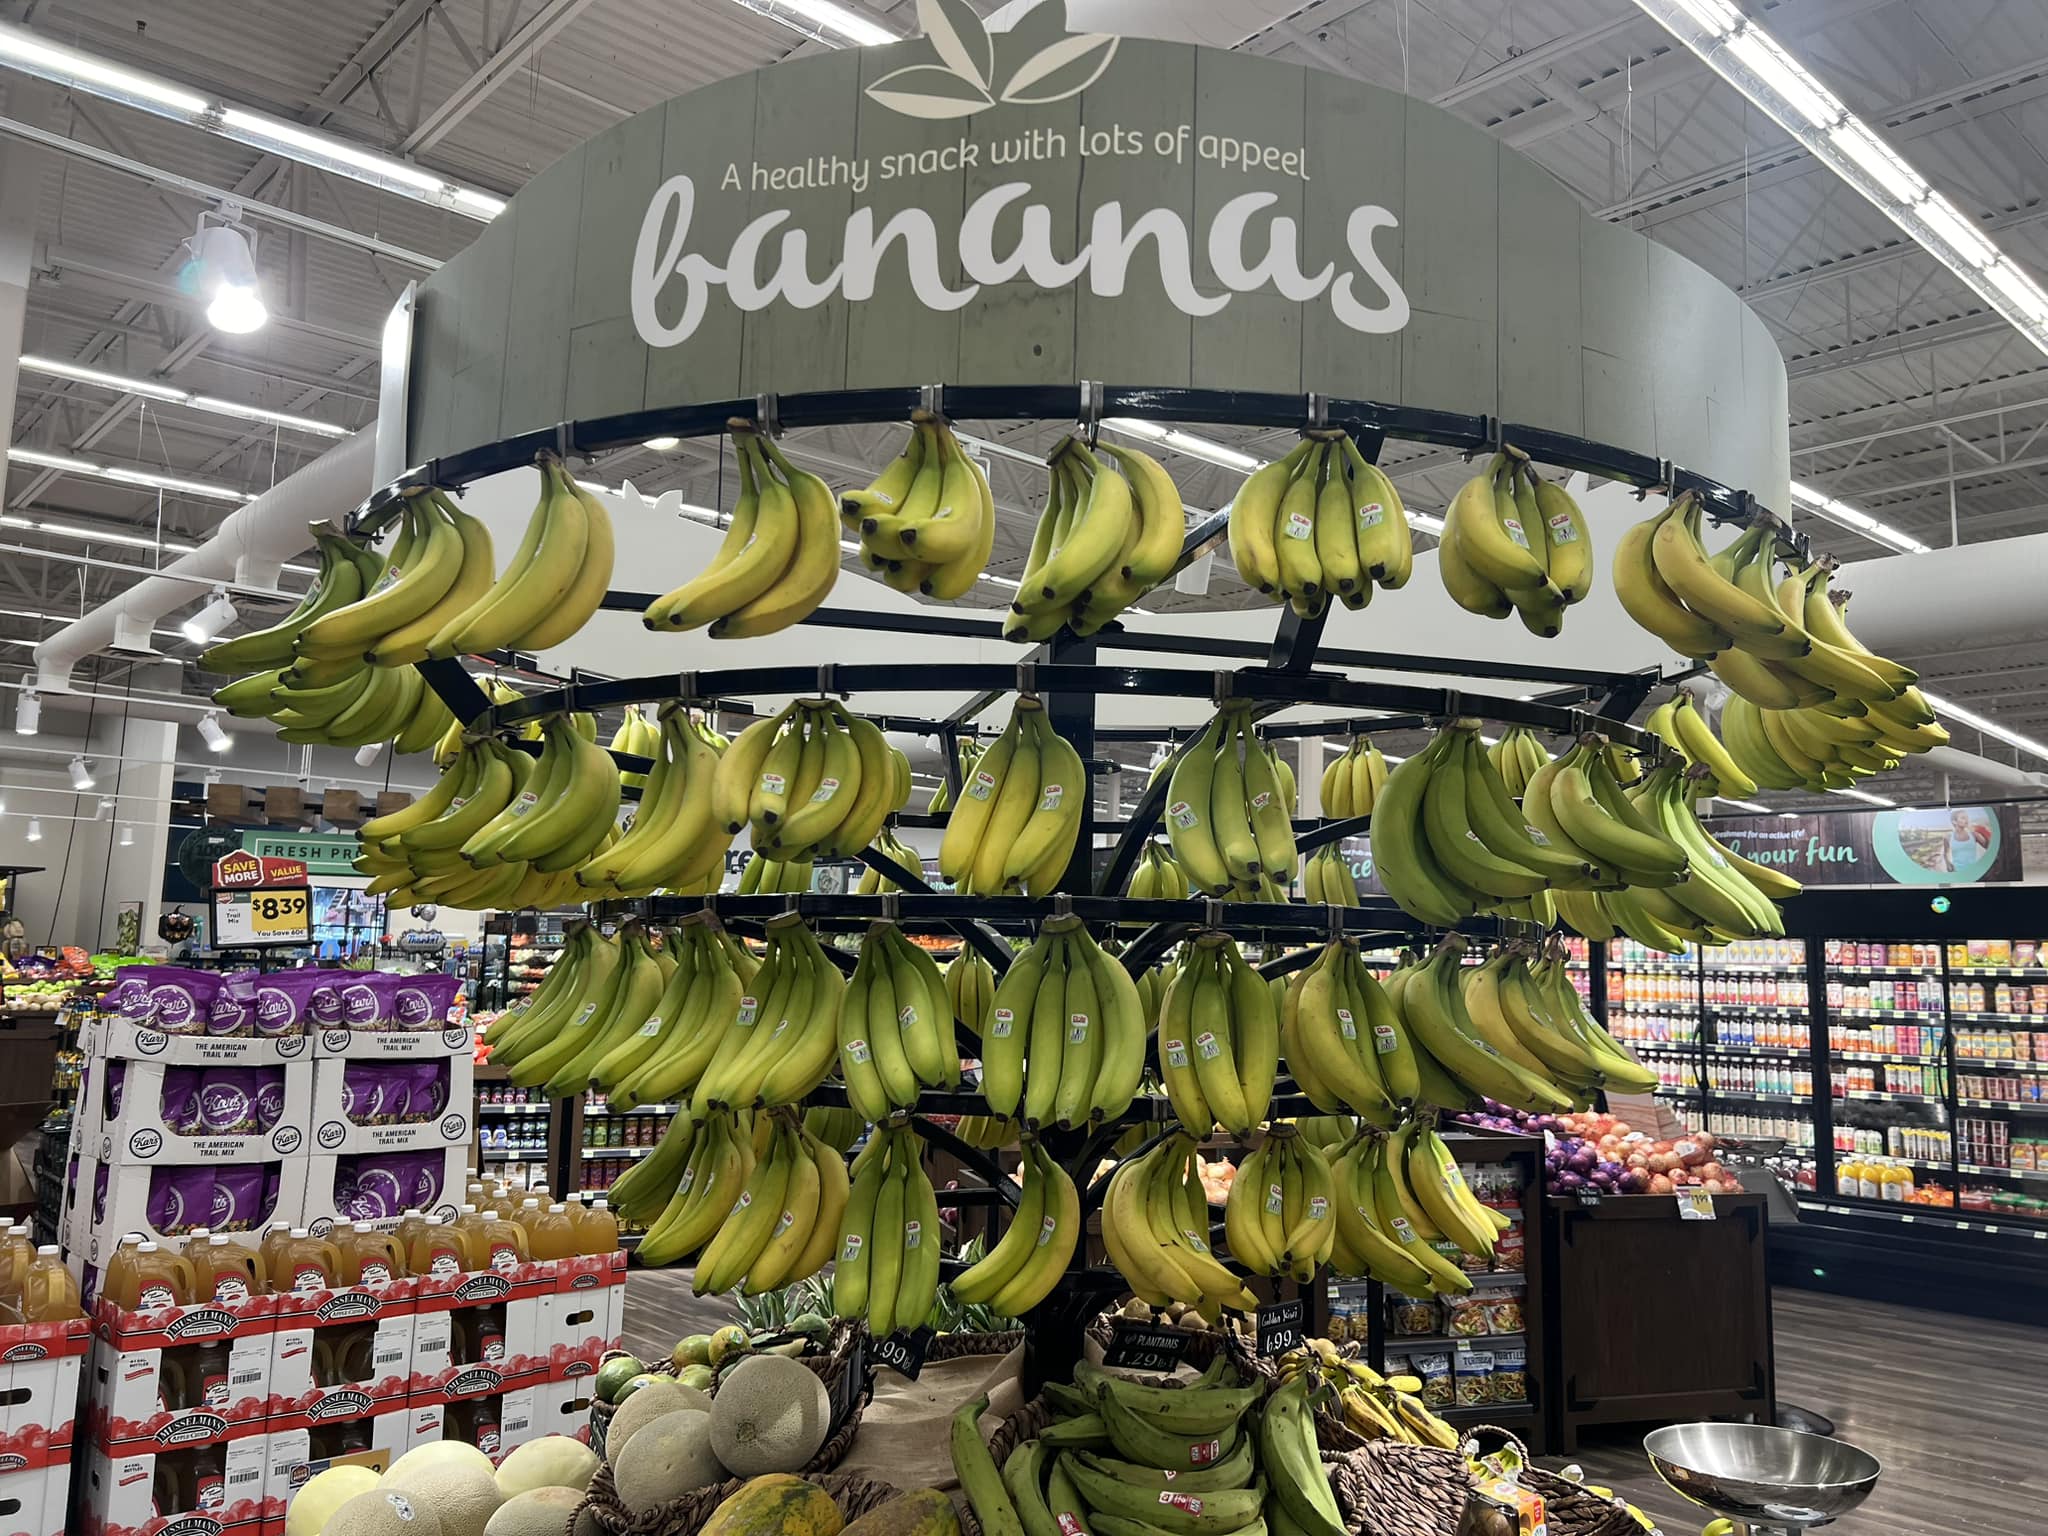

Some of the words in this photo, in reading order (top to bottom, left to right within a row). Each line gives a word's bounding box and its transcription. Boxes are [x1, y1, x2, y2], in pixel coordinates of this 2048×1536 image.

[721, 163, 742, 191] A
[751, 158, 869, 193] healthy
[880, 138, 979, 180] snack
[990, 129, 1065, 166] with
[1079, 126, 1143, 157] lots
[1154, 125, 1191, 163] of
[1199, 133, 1311, 180] appeel
[631, 175, 1410, 348] bananas
[263, 845, 321, 858] FRESH
[1806, 836, 1858, 866] fun
[224, 861, 257, 874] SAVE
[270, 865, 303, 878] VALUE
[224, 870, 259, 884] MORE
[209, 1043, 247, 1051] AMERICAN
[276, 1132, 299, 1147] Kar's
[321, 1127, 343, 1141] Kar's
[385, 1129, 416, 1138] AMERICAN
[133, 1134, 159, 1150] Kar's
[207, 1141, 244, 1149] AMERICAN
[376, 1223, 399, 1231] AMERIC
[1137, 1335, 1179, 1349] PLANTAINS
